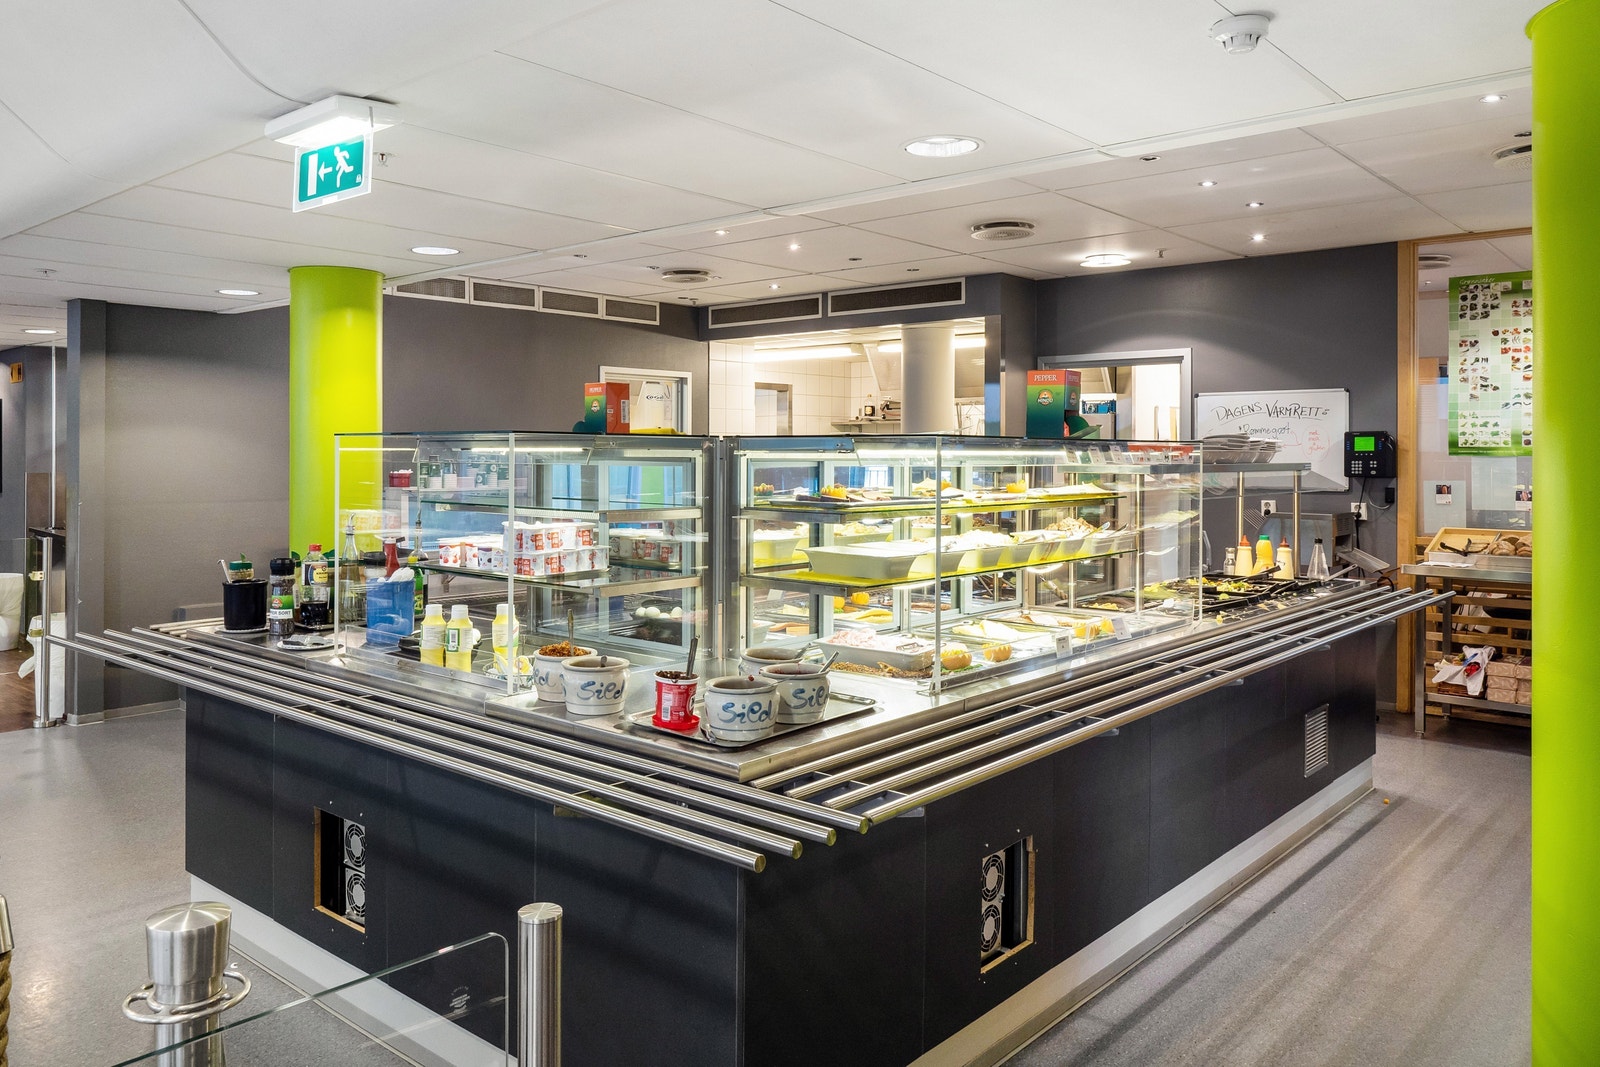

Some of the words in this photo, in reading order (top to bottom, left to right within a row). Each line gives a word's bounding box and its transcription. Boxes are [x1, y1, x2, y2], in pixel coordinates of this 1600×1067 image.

[1211, 402, 1263, 421] DAGENS
[577, 680, 626, 700] Sild
[717, 700, 774, 724] Sild
